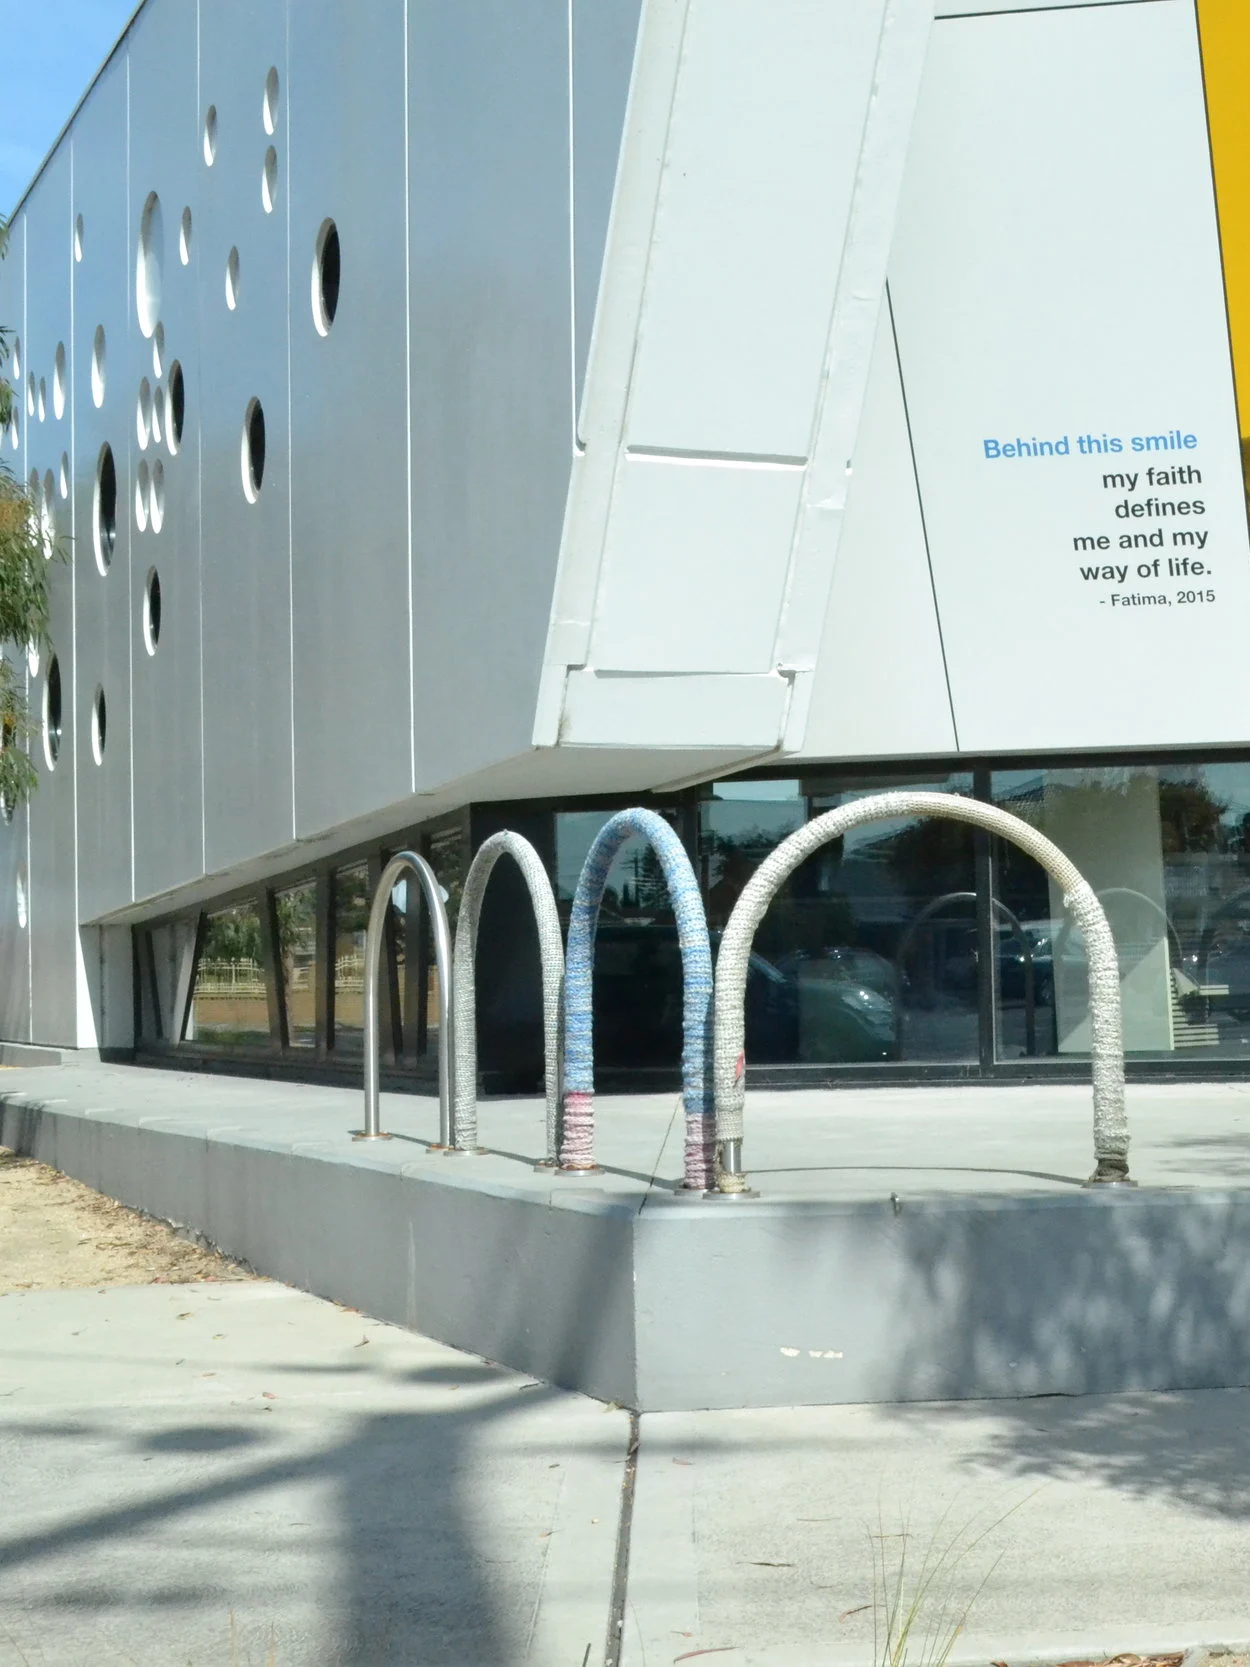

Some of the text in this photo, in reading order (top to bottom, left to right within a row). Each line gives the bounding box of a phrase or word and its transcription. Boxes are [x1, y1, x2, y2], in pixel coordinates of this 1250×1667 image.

[984, 430, 1197, 459] Behind this smile
[1103, 465, 1202, 492] my faith
[1115, 498, 1205, 518] defines
[1073, 528, 1208, 551] me and my
[1080, 557, 1211, 583] way of life.
[1111, 593, 1171, 606] Fatima,
[1177, 590, 1215, 603] 2015
